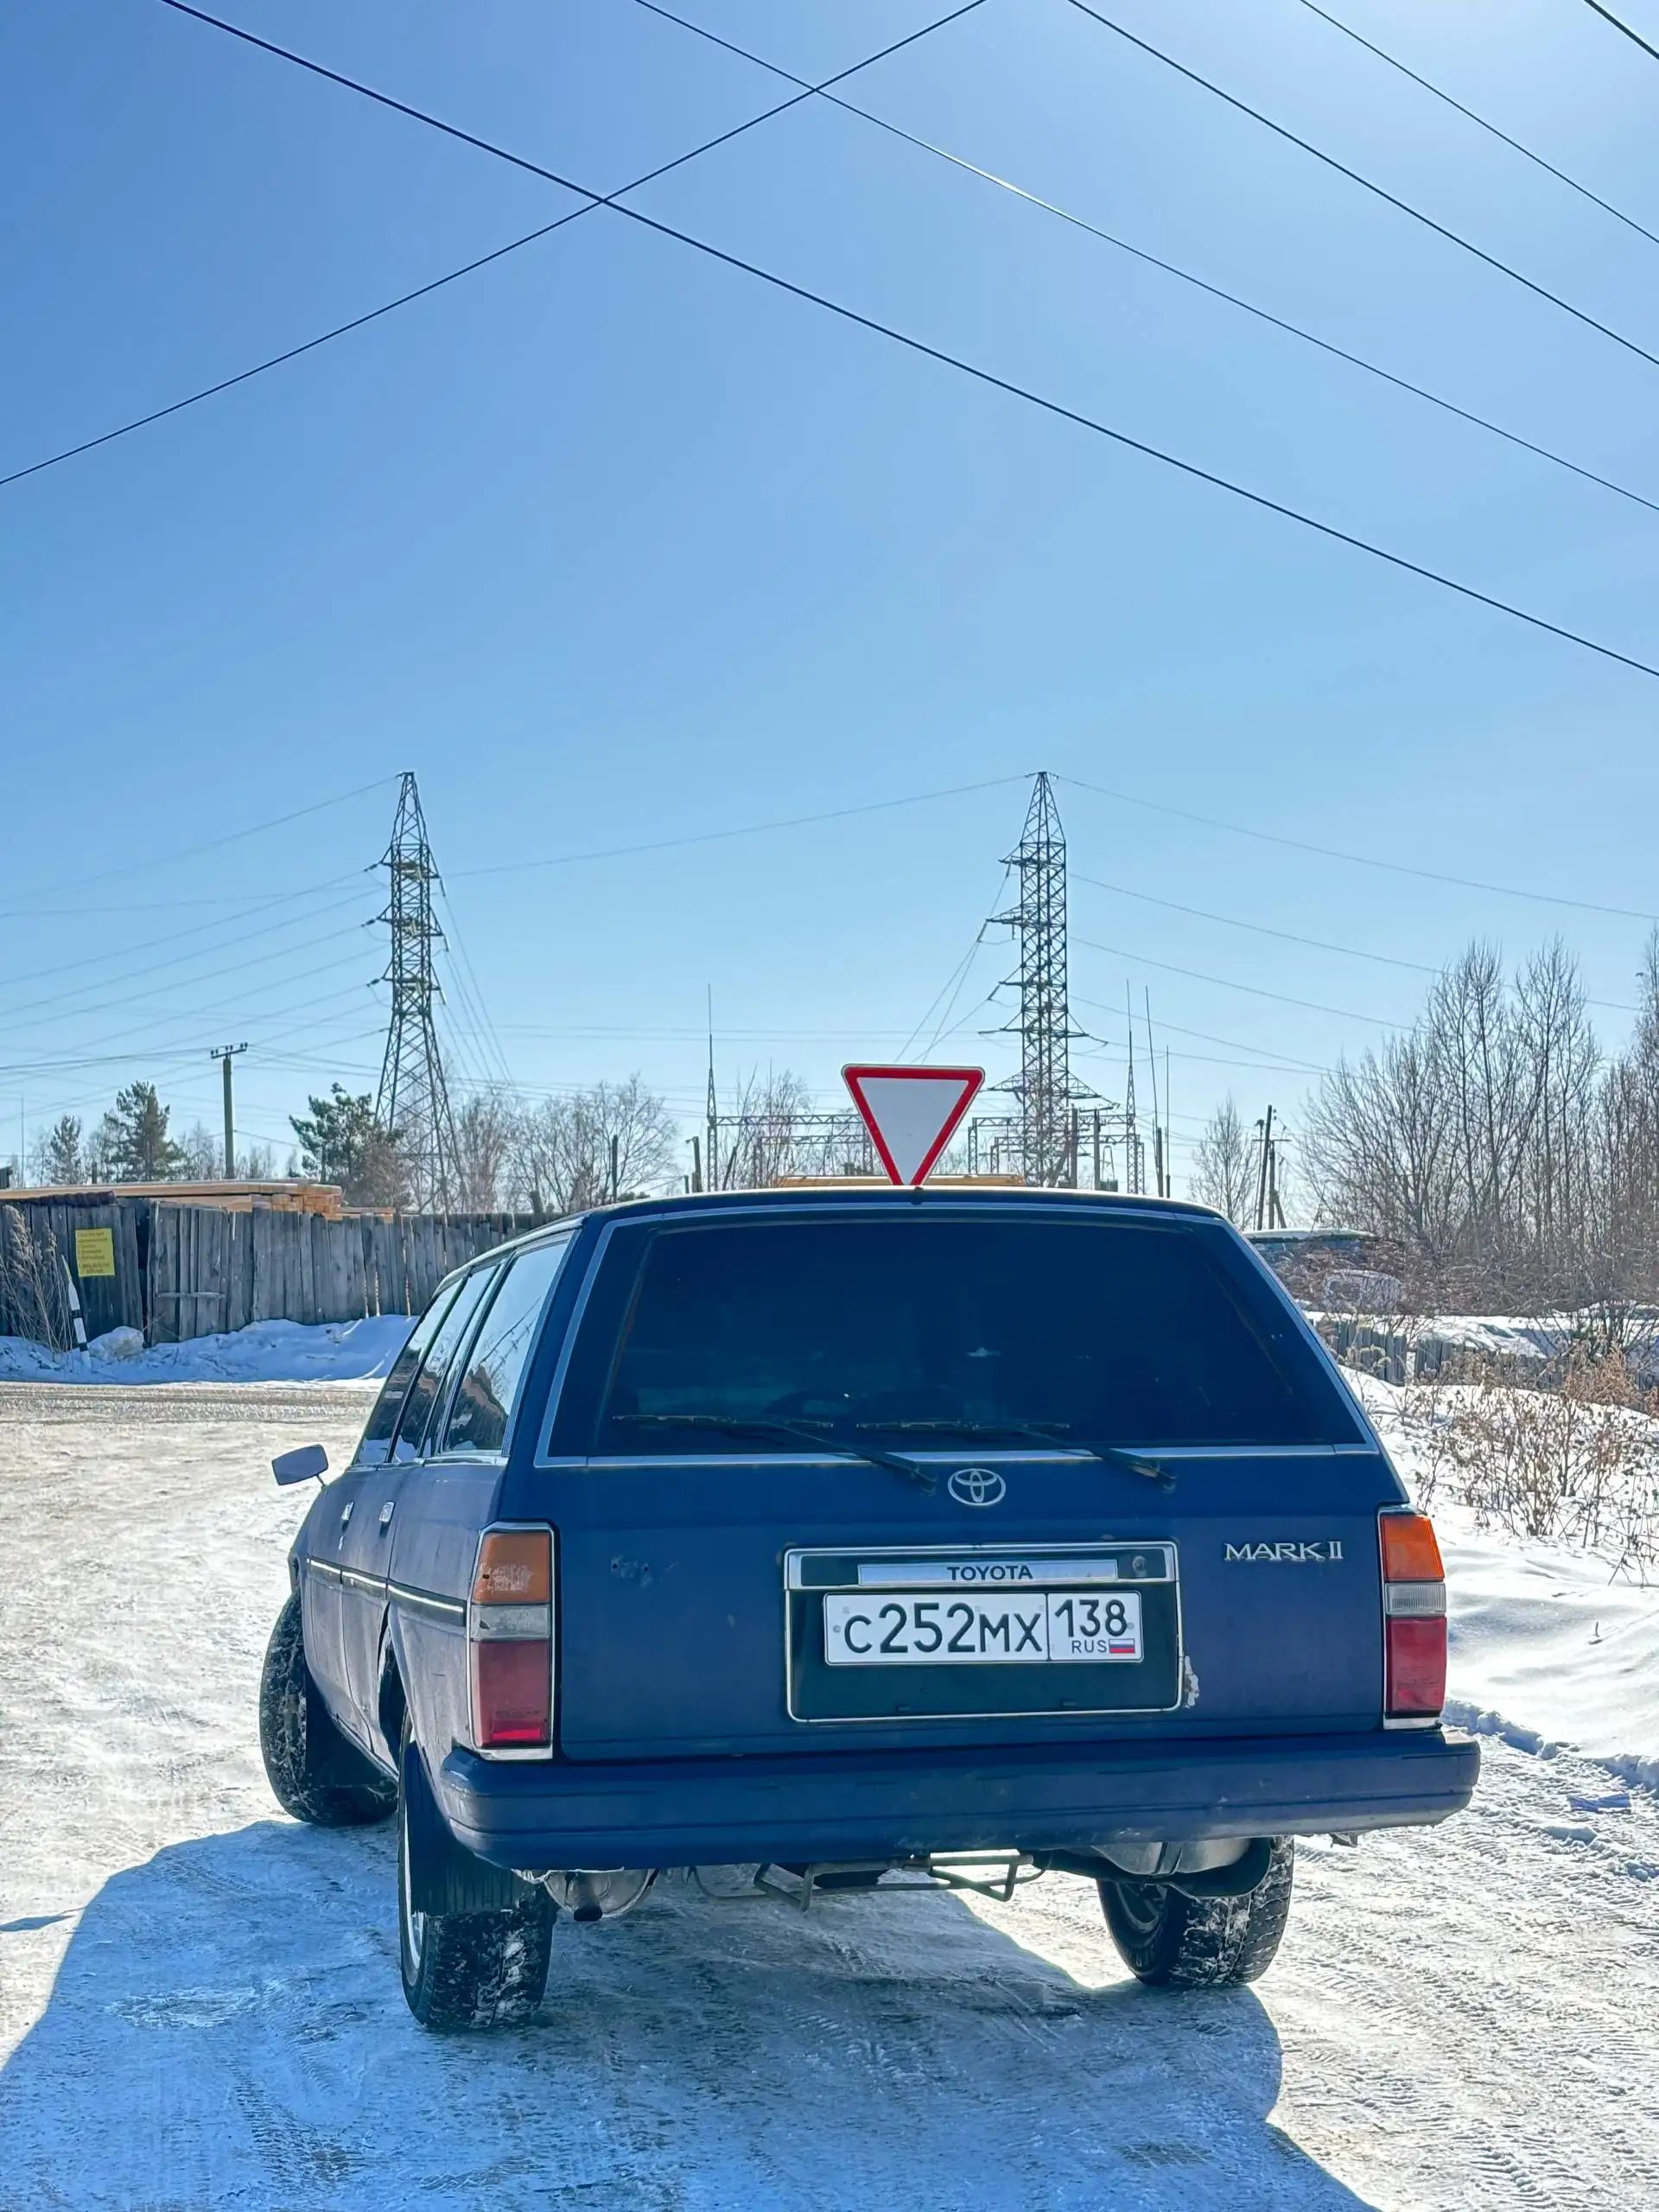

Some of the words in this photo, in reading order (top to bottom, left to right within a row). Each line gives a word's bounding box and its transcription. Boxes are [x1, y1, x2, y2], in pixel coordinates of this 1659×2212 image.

[1224, 1541, 1325, 1562] MARK
[1327, 1540, 1344, 1560] II
[946, 1565, 1033, 1581] TOYOTA
[1053, 1599, 1128, 1638] 138
[1071, 1639, 1108, 1654] RUS
